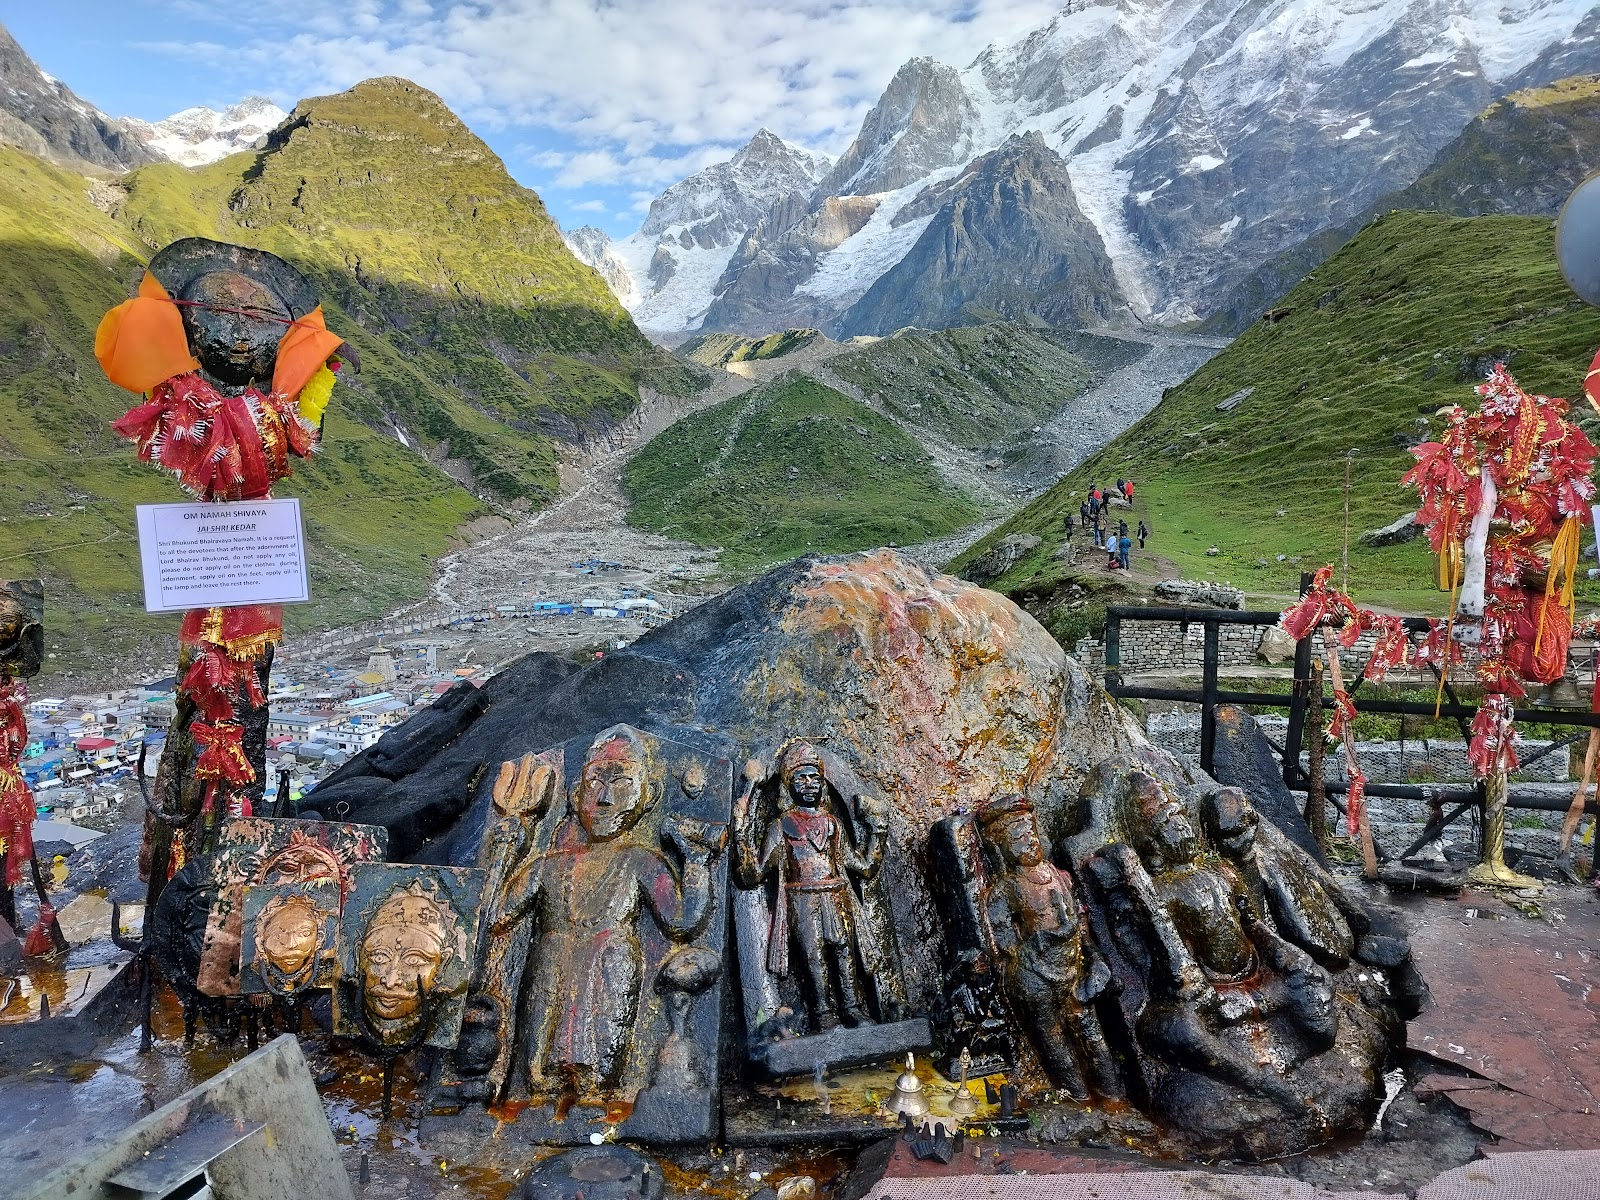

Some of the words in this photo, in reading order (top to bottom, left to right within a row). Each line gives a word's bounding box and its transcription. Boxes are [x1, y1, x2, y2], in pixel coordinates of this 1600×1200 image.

[200, 511, 231, 519] NAMAH
[233, 509, 267, 517] SHIVAYA
[230, 523, 256, 531] KEDAR
[161, 567, 181, 575] please
